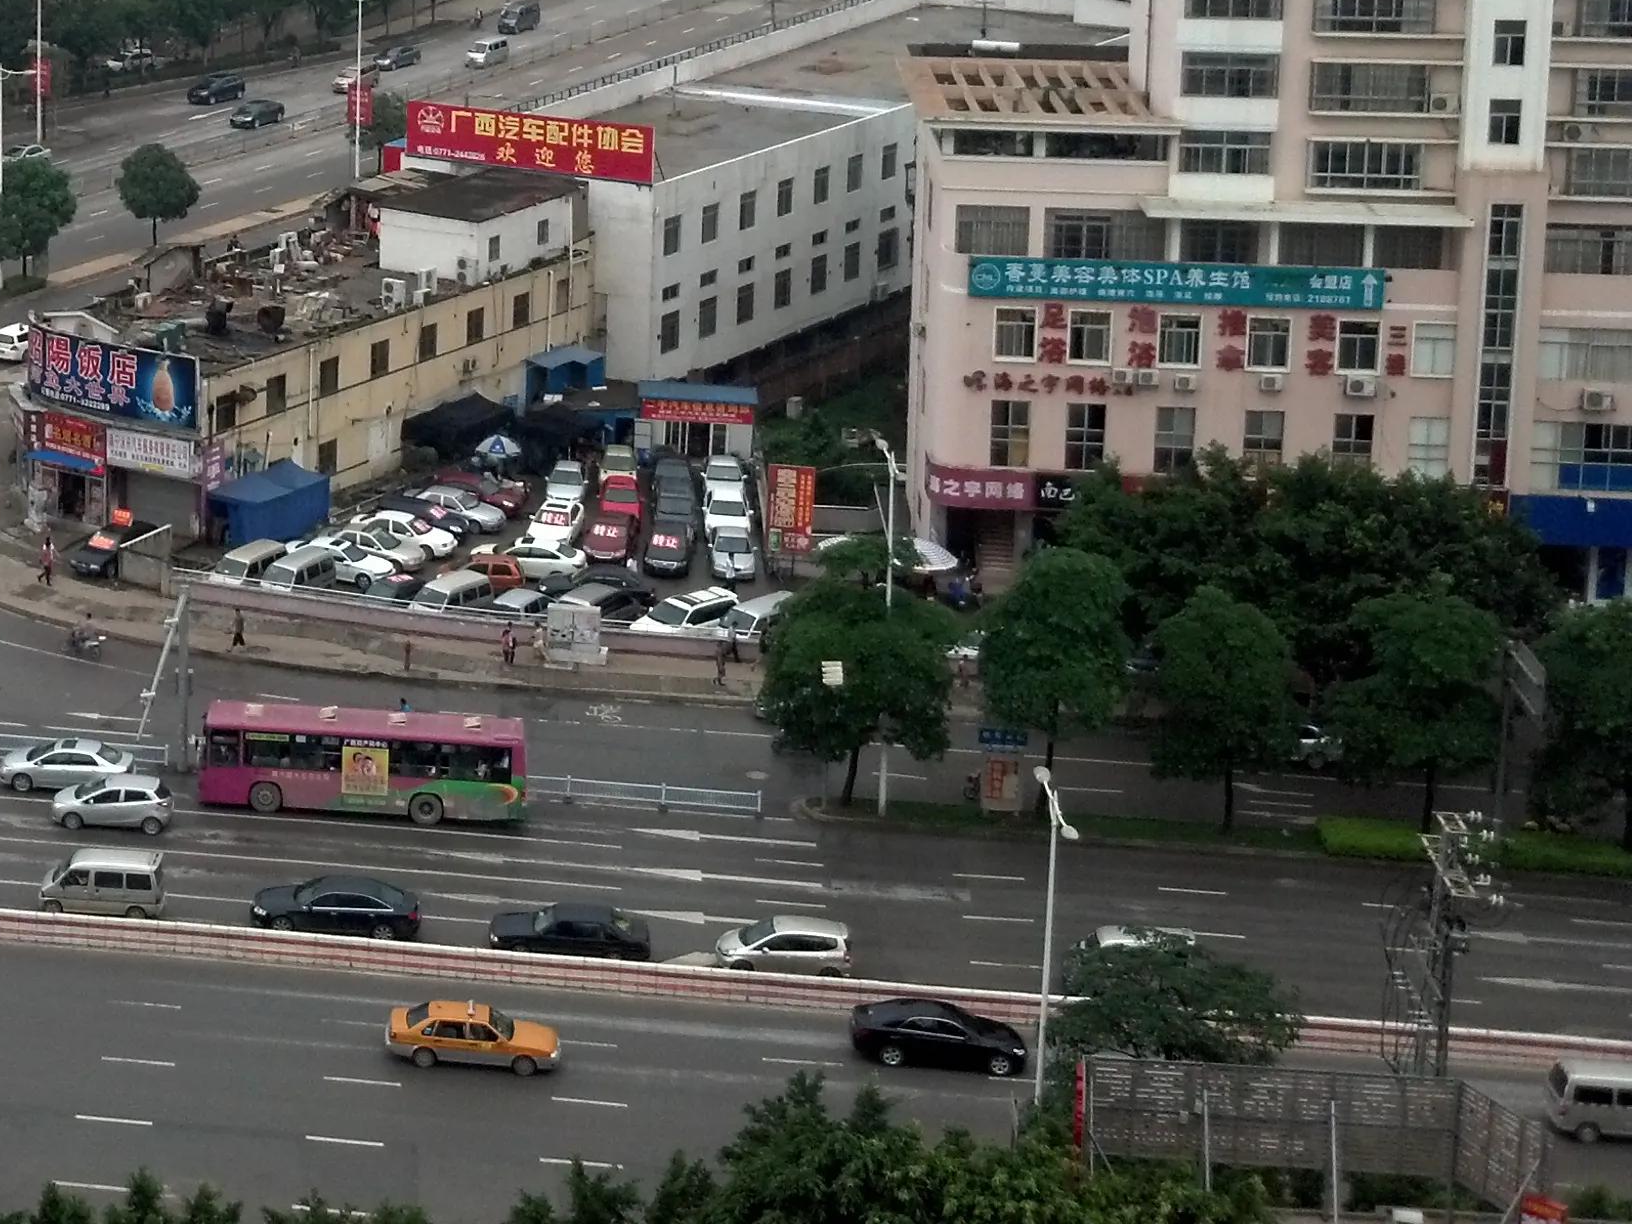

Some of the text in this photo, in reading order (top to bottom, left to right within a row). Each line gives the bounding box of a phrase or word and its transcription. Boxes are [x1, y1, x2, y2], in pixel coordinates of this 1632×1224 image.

[449, 110, 645, 153] 广西汽车配件协会
[495, 142, 595, 174] 欢迎您
[593, 523, 619, 538] 转让
[652, 533, 679, 549] 转让
